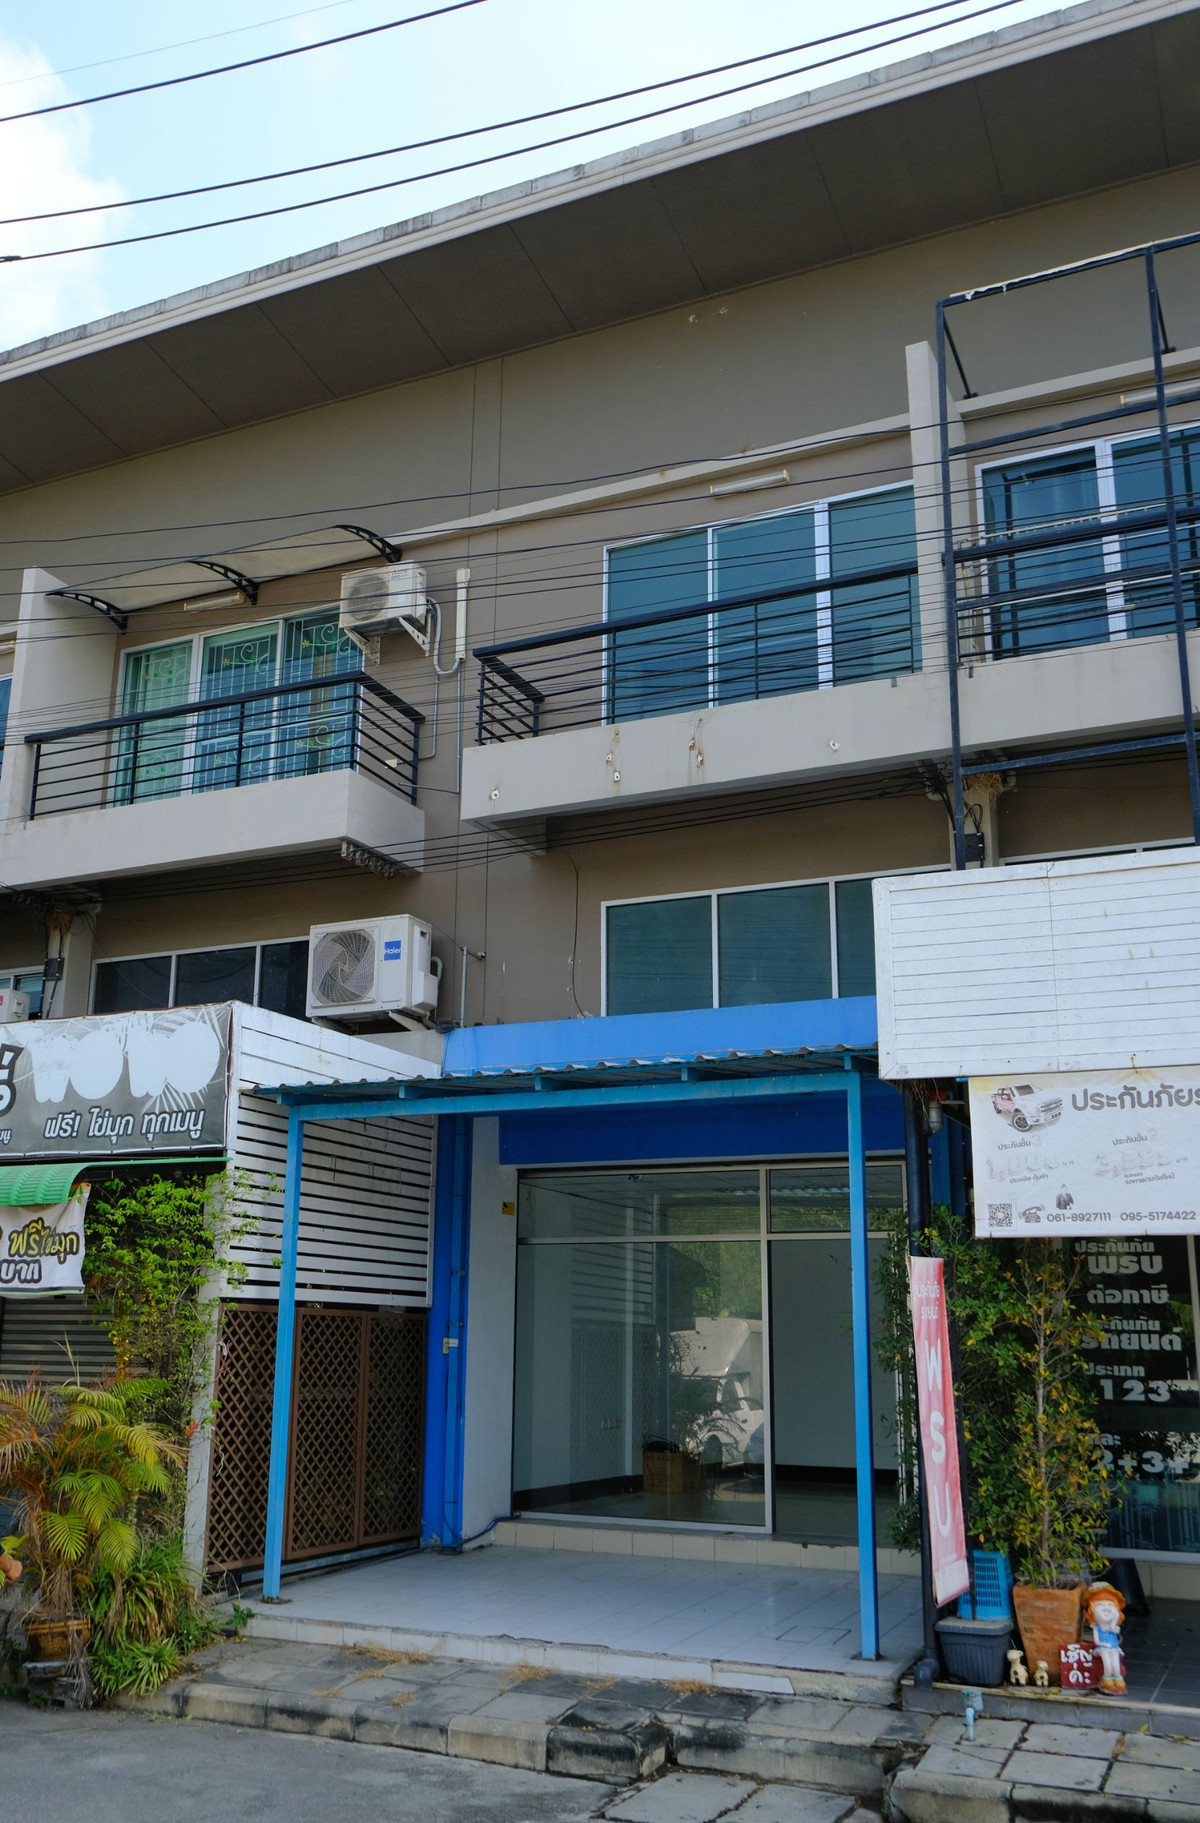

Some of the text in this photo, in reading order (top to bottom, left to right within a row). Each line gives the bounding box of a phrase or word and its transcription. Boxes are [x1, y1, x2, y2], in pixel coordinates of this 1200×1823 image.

[44, 1106, 205, 1144] ฟรี! ไข่มุก ทุกเมนู
[1047, 1211, 1196, 1222] 061-8927111 095-5174422
[1074, 1238, 1155, 1253] ประกันภัย
[0, 1259, 42, 1283] บาท
[1086, 1284, 1169, 1304] ต่อภาษี
